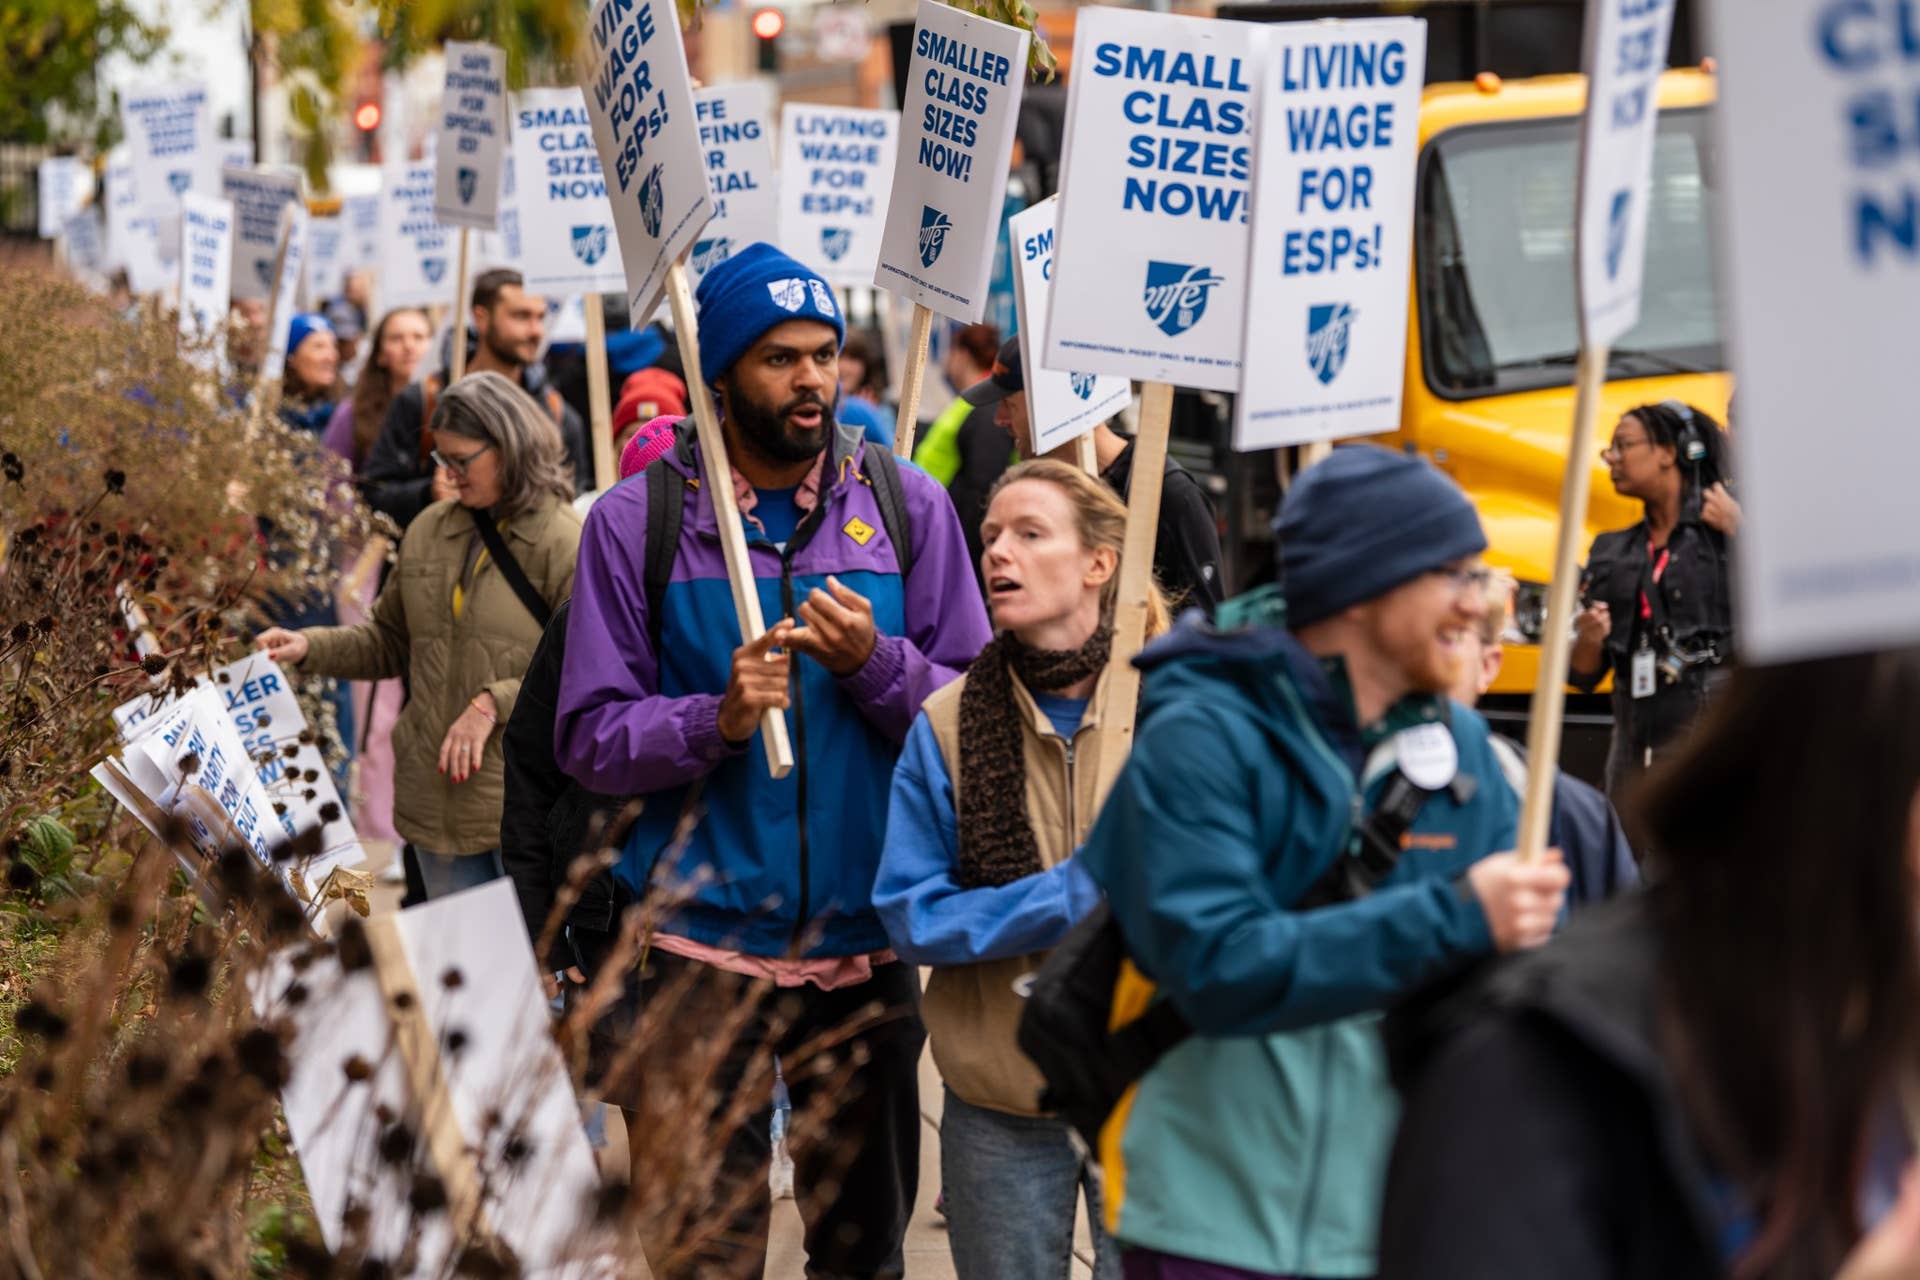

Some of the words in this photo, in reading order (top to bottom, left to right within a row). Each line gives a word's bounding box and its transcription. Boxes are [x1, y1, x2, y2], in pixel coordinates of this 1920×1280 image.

[594, 3, 655, 112] WAGE
[916, 28, 1010, 86] SMALLER
[1093, 43, 1249, 92] SMALL
[1283, 41, 1406, 91] LIVING
[610, 60, 653, 143] FOR
[924, 68, 988, 115] CLASS
[1123, 90, 1251, 135] CLAS
[540, 132, 596, 151] CLA
[616, 89, 668, 193] ESPs!
[795, 116, 886, 139] LIVING
[923, 103, 978, 148] SIZES
[1287, 102, 1394, 152] WAGE
[800, 142, 879, 165] WAGE
[918, 136, 973, 183] NOW!
[811, 168, 865, 188] FOR
[1123, 177, 1249, 224] NOW!
[1297, 165, 1372, 214] FOR
[1283, 223, 1382, 276] ESPs!
